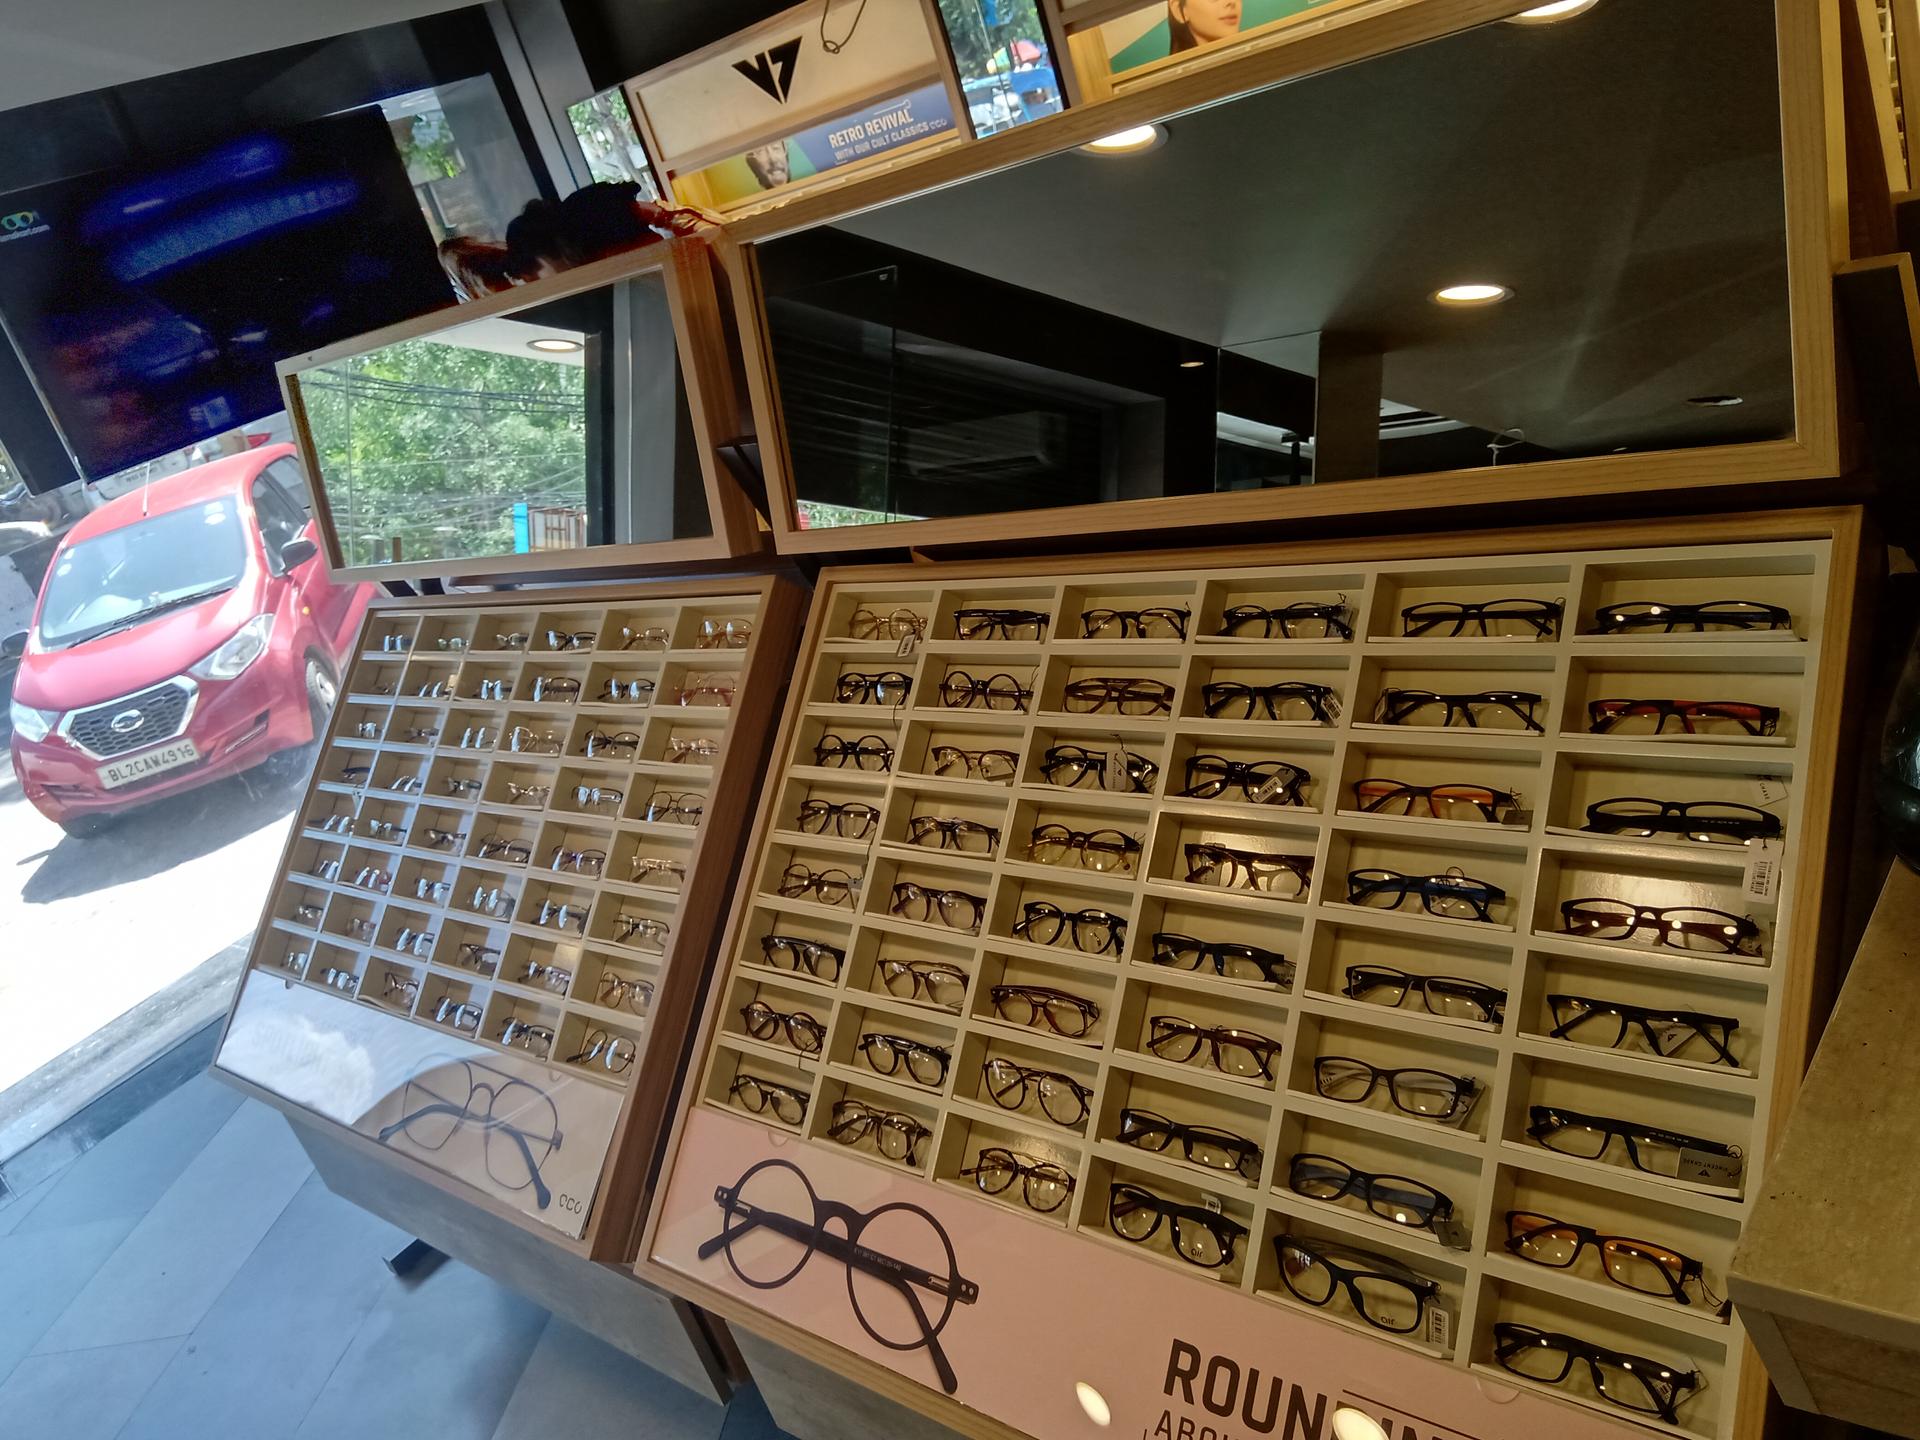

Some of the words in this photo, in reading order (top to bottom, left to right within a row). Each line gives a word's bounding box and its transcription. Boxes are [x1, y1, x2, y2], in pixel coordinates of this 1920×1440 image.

[828, 125, 865, 148] RETRO
[864, 109, 914, 136] REVIVAL
[854, 141, 872, 154] OUR
[871, 134, 891, 149] CULT
[890, 121, 930, 142] CLASSICS
